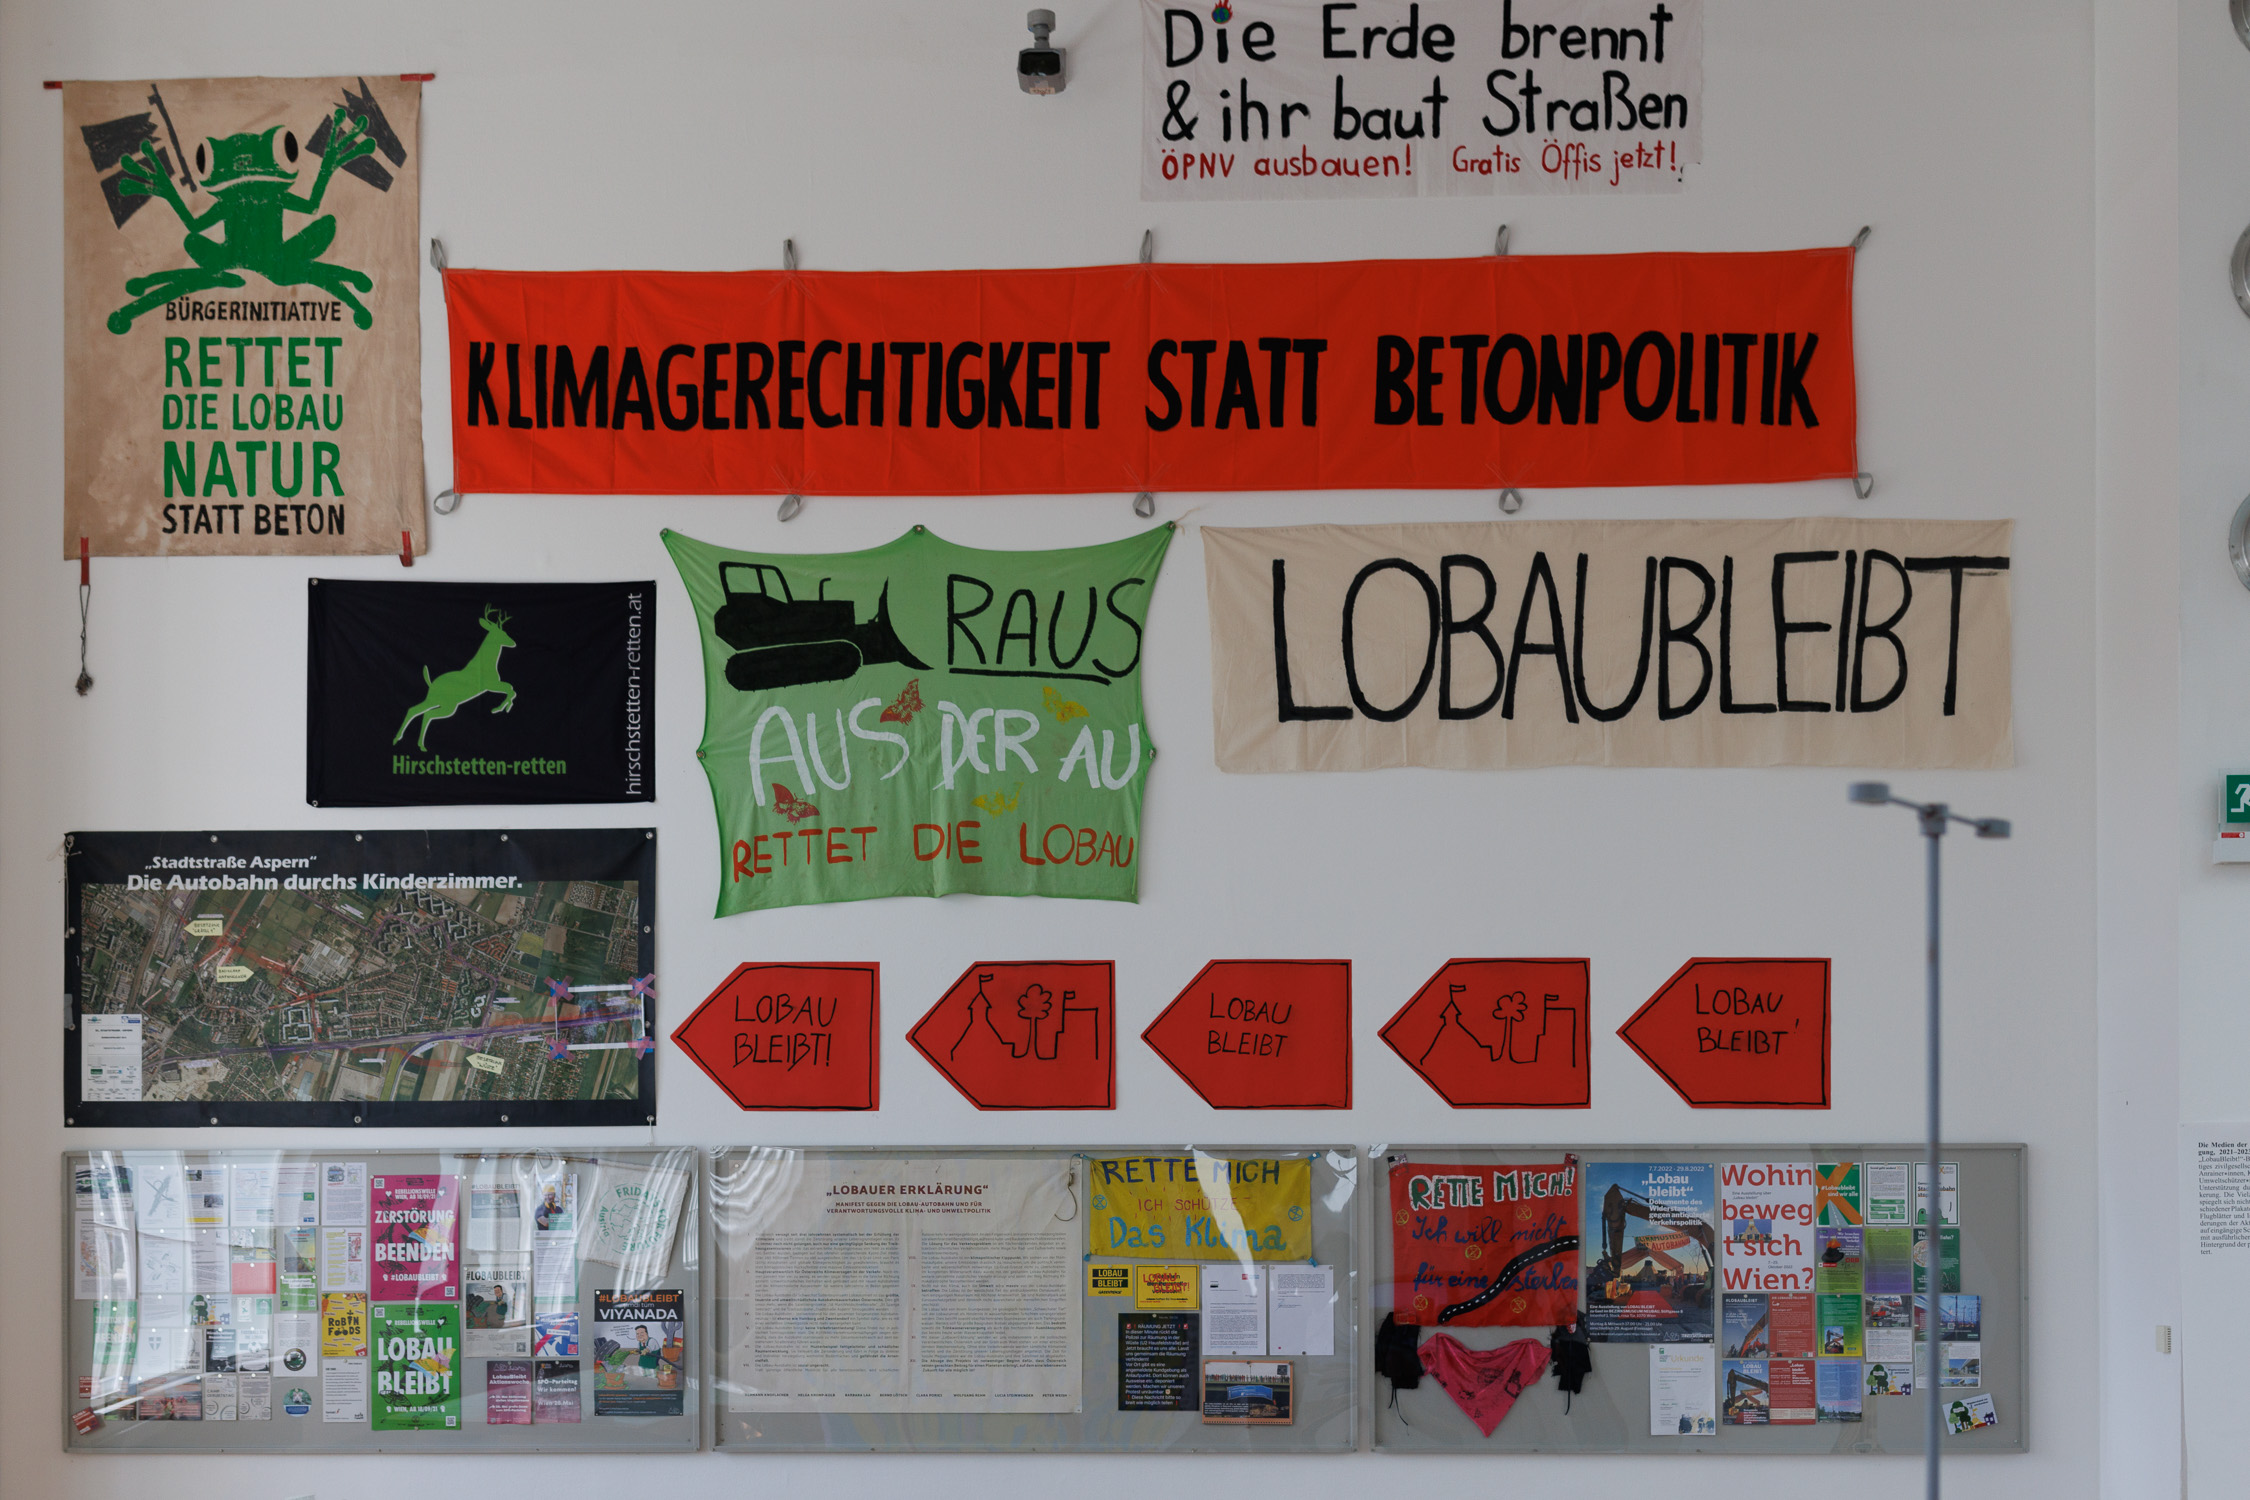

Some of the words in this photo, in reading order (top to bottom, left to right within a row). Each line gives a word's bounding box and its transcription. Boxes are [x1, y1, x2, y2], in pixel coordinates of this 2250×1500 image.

[1164, 2, 1277, 67] Die
[1322, 2, 1456, 62] Erde
[1500, 1, 1673, 63] brennt
[1161, 79, 1198, 142] &
[1219, 75, 1310, 142] ihr
[1333, 74, 1449, 140] baut
[1482, 68, 1688, 137] Straßen
[1161, 147, 1235, 180] ÖPNV
[1254, 143, 1413, 178] ausbauen!
[1452, 143, 1521, 177] Gratis
[1541, 137, 1602, 183] Öffis
[1610, 140, 1677, 186] jetzt!
[165, 299, 342, 323] BÜRGERINITIATIVE
[163, 336, 344, 389] RETTET
[466, 339, 1111, 432] KLIMAGERECHTIGKEIT
[1144, 336, 1328, 432] STATT
[1373, 329, 1820, 429] BETONPOLITIK
[161, 393, 219, 432] DIE
[231, 392, 345, 432] LOBAU
[161, 440, 346, 499] NATUR
[161, 504, 245, 535] STATT
[253, 503, 346, 536] BETON
[946, 573, 1146, 678] RAUS
[1271, 548, 2010, 724] LOBAUBLEIBT
[624, 592, 644, 796] hirschstetten-retten.at
[392, 754, 567, 776] Hirschstetten-retten
[748, 696, 911, 807] AUS
[933, 700, 1040, 791] DER
[1057, 722, 1140, 791] AU
[145, 856, 246, 871] „Stadtstraße
[249, 855, 318, 872] Aspern“
[732, 825, 878, 884] RETTET
[912, 820, 984, 864] DIE
[1018, 821, 1134, 868] LOBAU
[126, 874, 164, 891] Die
[166, 873, 278, 891] Autobahn
[283, 873, 358, 891] durchs
[362, 872, 523, 891] Kinderzimmer.
[734, 994, 838, 1029] LOBAU
[1209, 992, 1292, 1025] LOBAU
[1695, 983, 1784, 1015] LOBAU
[732, 1033, 833, 1072] BLEIBT!
[1207, 1030, 1288, 1058] BLEIBT
[1102, 1157, 1198, 1185] RETTE
[1212, 1160, 1280, 1185] MICH
[1641, 1173, 1689, 1186] „Lobau
[1721, 1164, 1812, 1187] Wohin
[900, 1182, 989, 1195] ERKLÄRUNG“
[1409, 1174, 1483, 1211] RETTE
[1493, 1167, 1575, 1202] MICH!
[1648, 1185, 1694, 1198] bleibt“
[1649, 1198, 1690, 1206] Dokumente
[1690, 1198, 1703, 1206] des
[375, 1207, 455, 1224] ZERSTÖRUNG
[1137, 1198, 1163, 1212] ICH
[1722, 1199, 1813, 1226] beweg
[1109, 1215, 1165, 1249] Das
[1185, 1215, 1288, 1252] Klima
[1411, 1215, 1448, 1243] Ich
[1454, 1217, 1500, 1245] will
[1509, 1212, 1567, 1242] nicht
[1649, 1219, 1703, 1227] Verkehrspolitik
[375, 1242, 455, 1262] BEENDEN
[1723, 1236, 1735, 1256] t
[1744, 1234, 1803, 1256] sich
[2200, 1241, 2236, 1249] Hintergrund
[1097, 1279, 1123, 1288] BLEIBT
[1098, 1269, 1123, 1277] LOBAU
[1142, 1272, 1178, 1283] LOBAU
[1413, 1261, 1443, 1294] für
[1448, 1272, 1489, 1290] eine
[1506, 1261, 1579, 1292] sterben
[1723, 1267, 1813, 1290] Wien?
[1152, 1281, 1190, 1294] BLEIBT!
[599, 1308, 679, 1320] VIYANADA
[377, 1337, 453, 1362] LOBAU
[377, 1370, 453, 1395] BLEIBT
